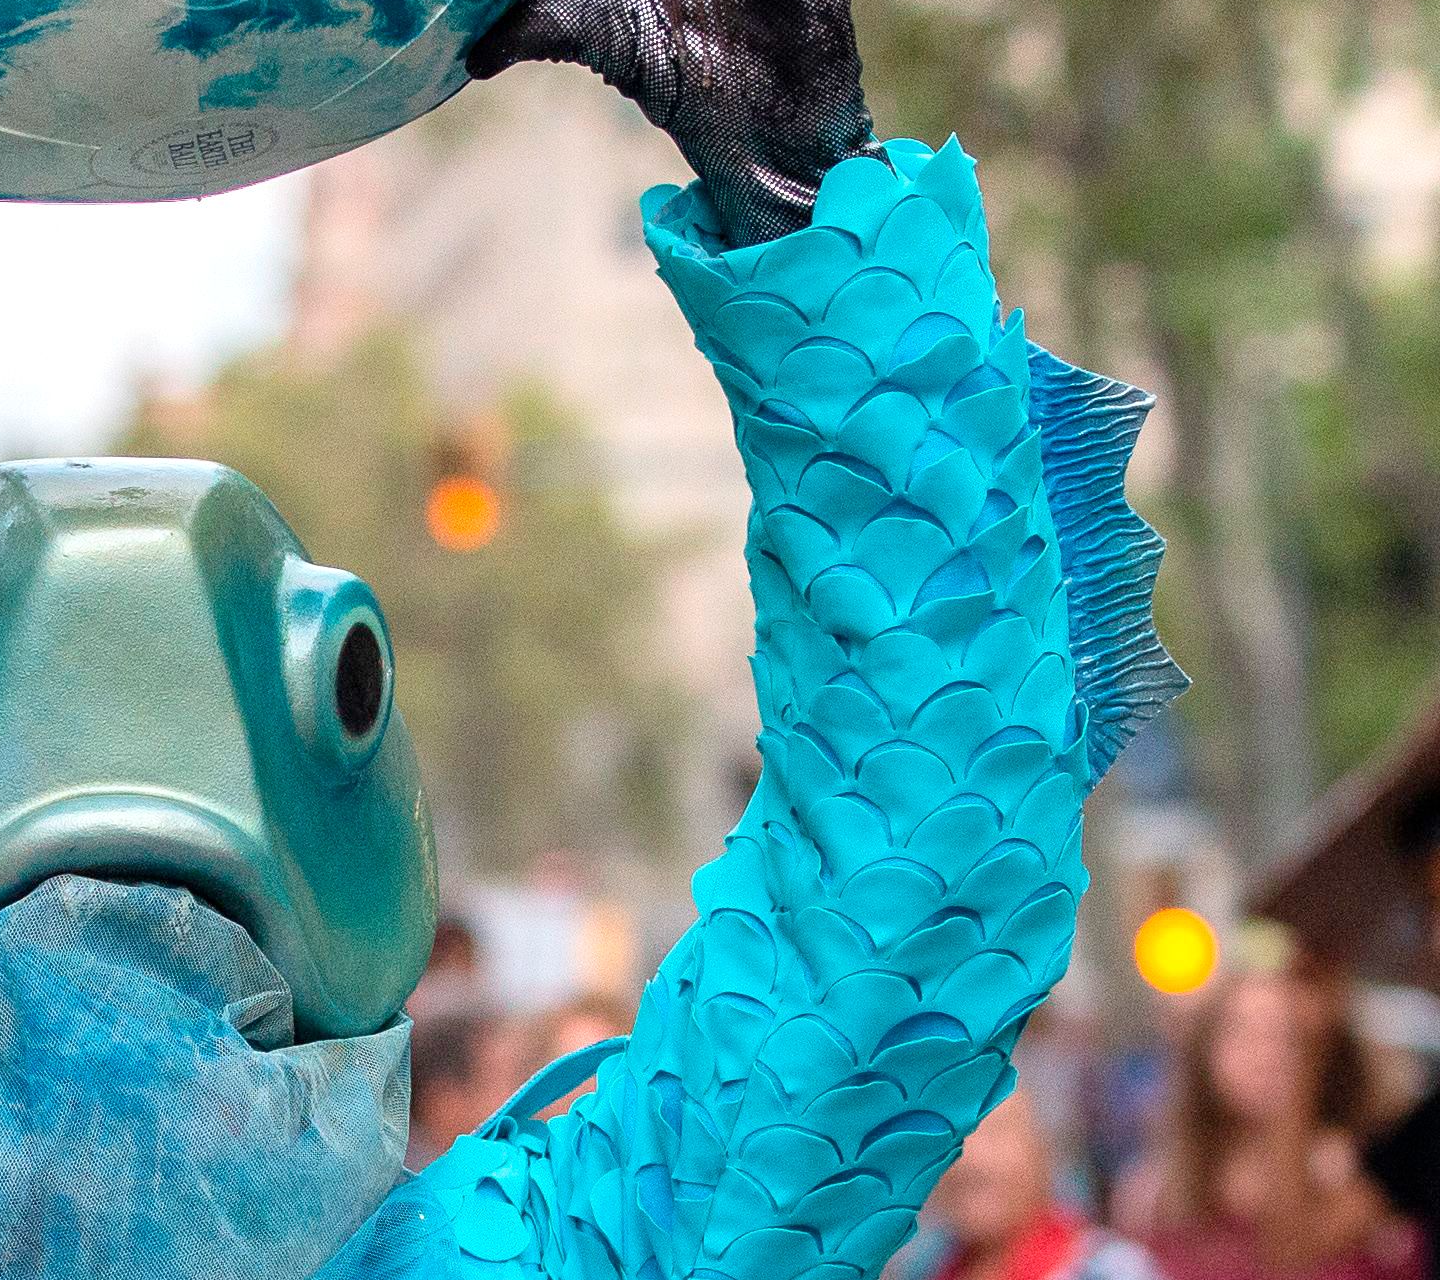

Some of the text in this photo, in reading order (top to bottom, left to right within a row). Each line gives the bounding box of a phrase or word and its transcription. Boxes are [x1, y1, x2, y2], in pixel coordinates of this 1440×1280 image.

[168, 140, 198, 170] BALL
[197, 130, 229, 169] EARTH
[228, 130, 256, 157] THE
